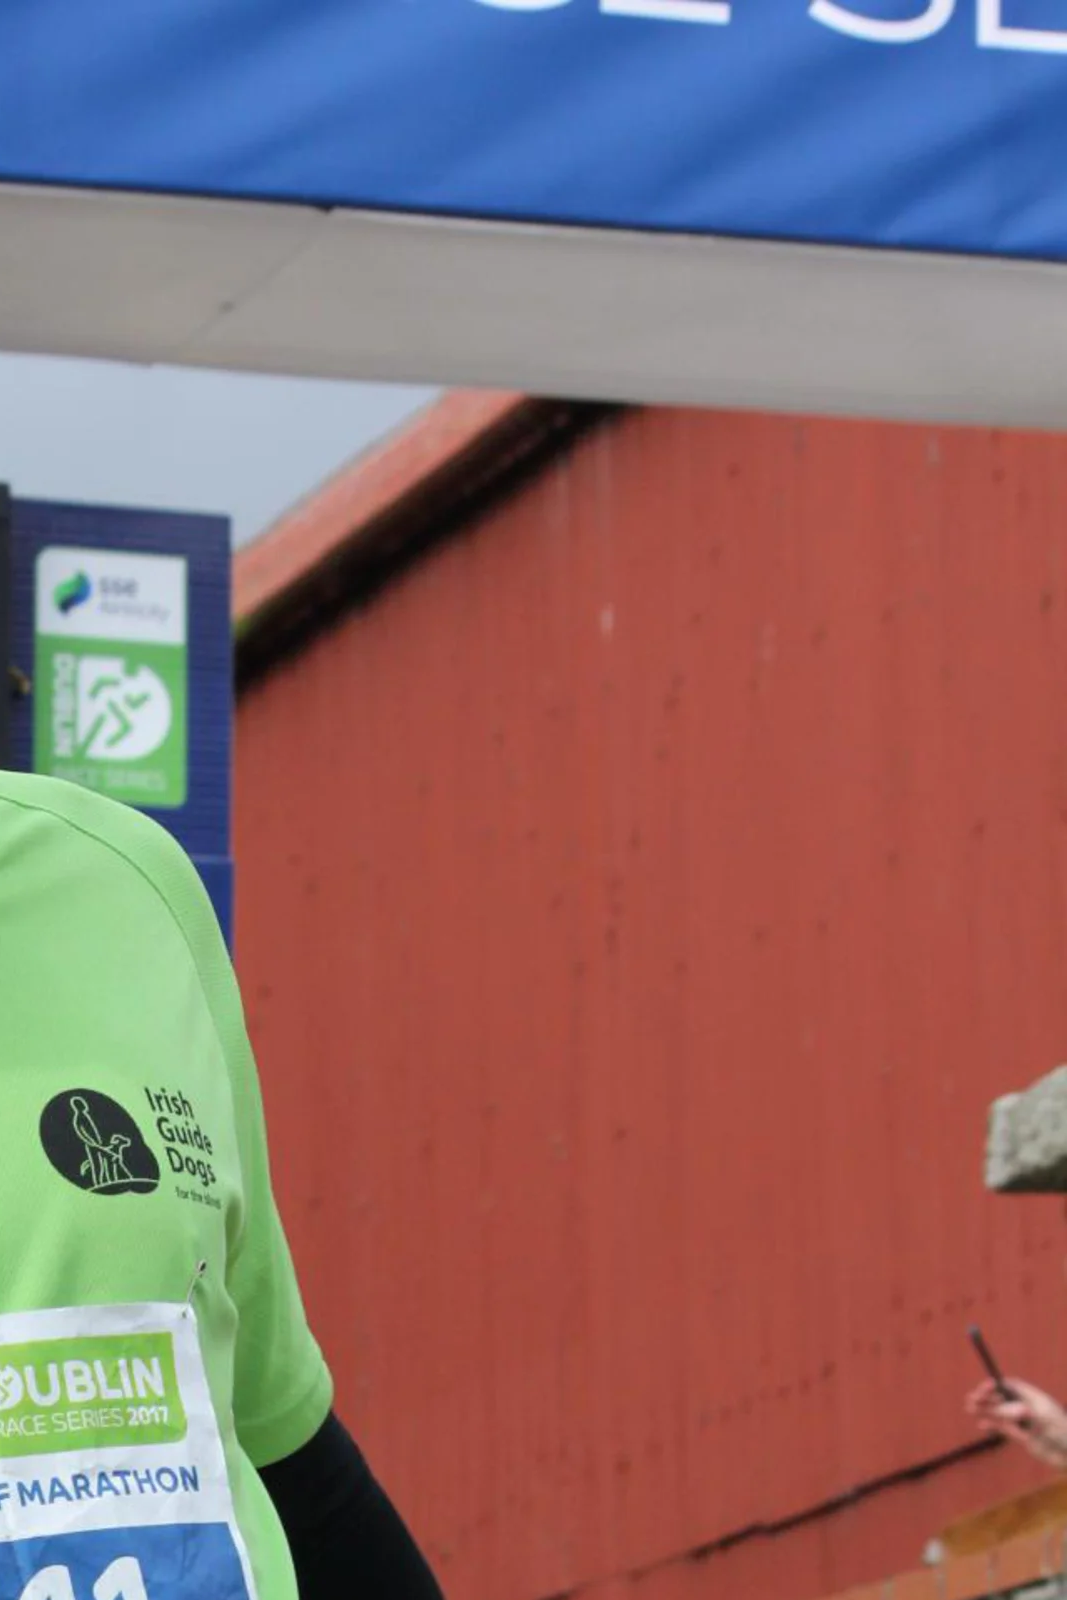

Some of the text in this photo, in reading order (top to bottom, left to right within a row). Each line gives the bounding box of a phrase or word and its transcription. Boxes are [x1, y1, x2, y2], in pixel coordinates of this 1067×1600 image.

[144, 1086, 195, 1119] Irish
[156, 1116, 213, 1156] Guide
[166, 1146, 216, 1187] Dogs
[50, 1407, 124, 1434] SERIES
[126, 1404, 169, 1427] 2017
[18, 1465, 201, 1508] MARATHON
